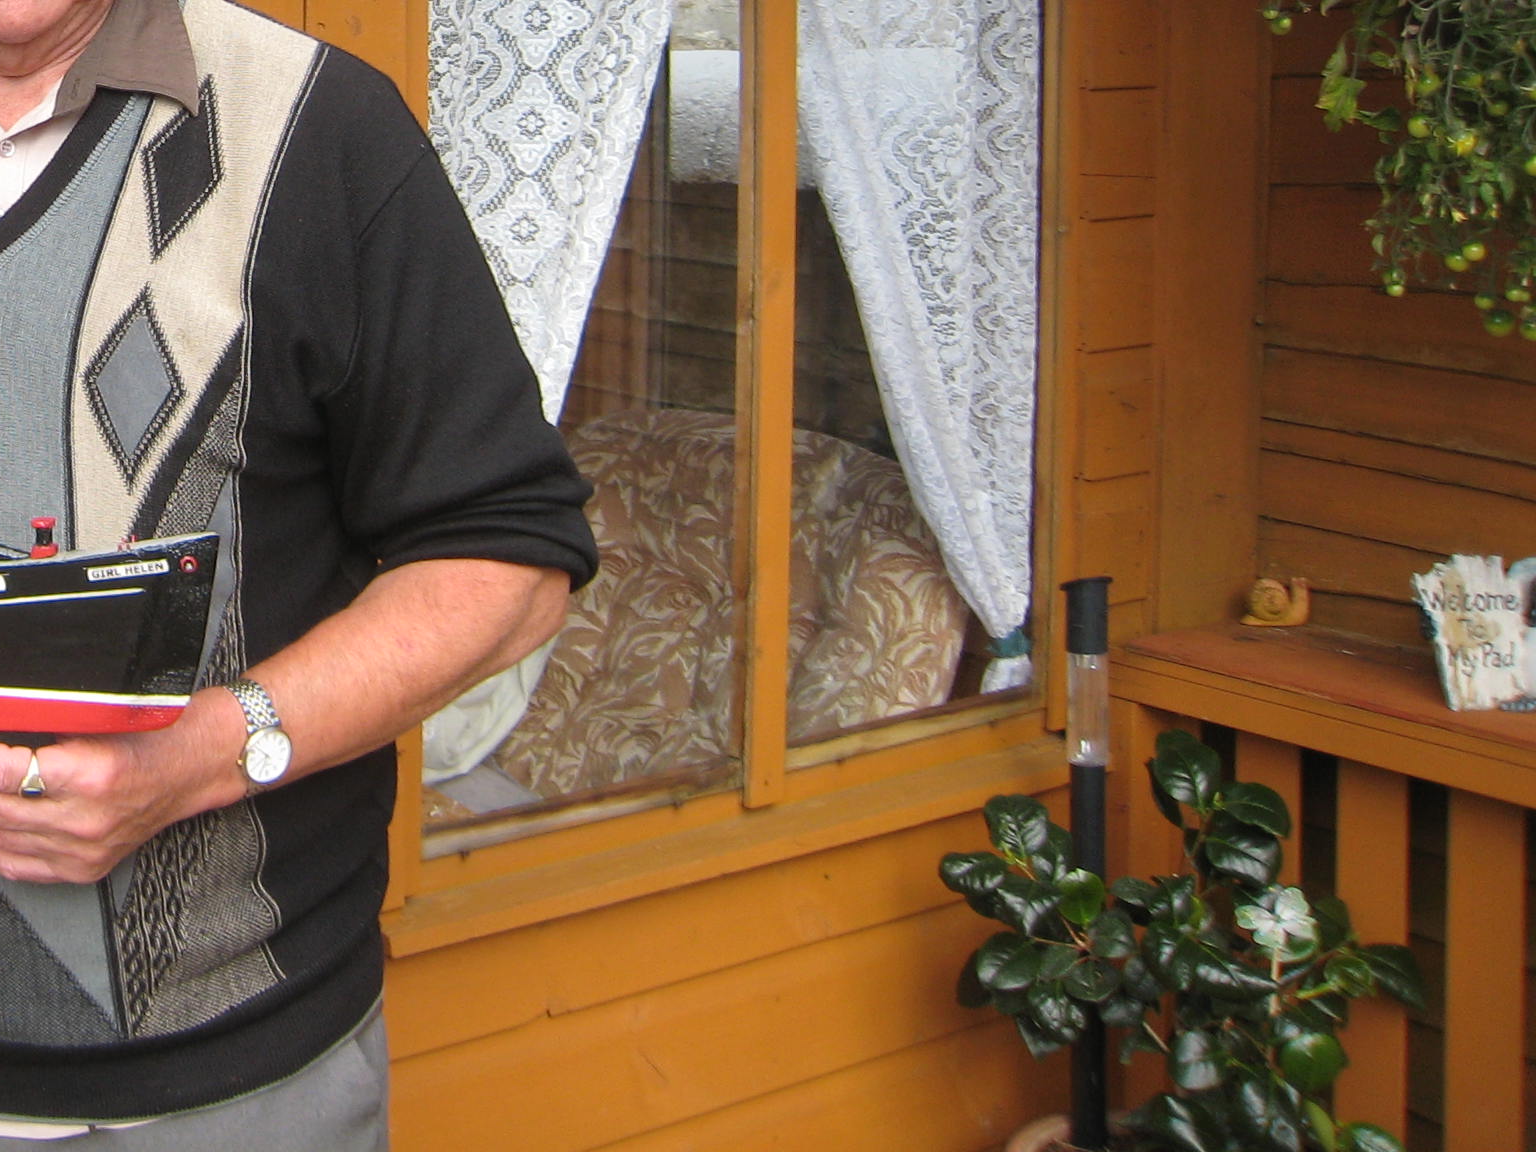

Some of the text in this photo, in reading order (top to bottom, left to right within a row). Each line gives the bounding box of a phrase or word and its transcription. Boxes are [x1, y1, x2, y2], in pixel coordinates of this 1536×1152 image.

[91, 562, 165, 579] GIRL HELEN
[1421, 580, 1518, 612] Welcome
[1456, 617, 1487, 640] To
[1447, 641, 1515, 678] My Pad
